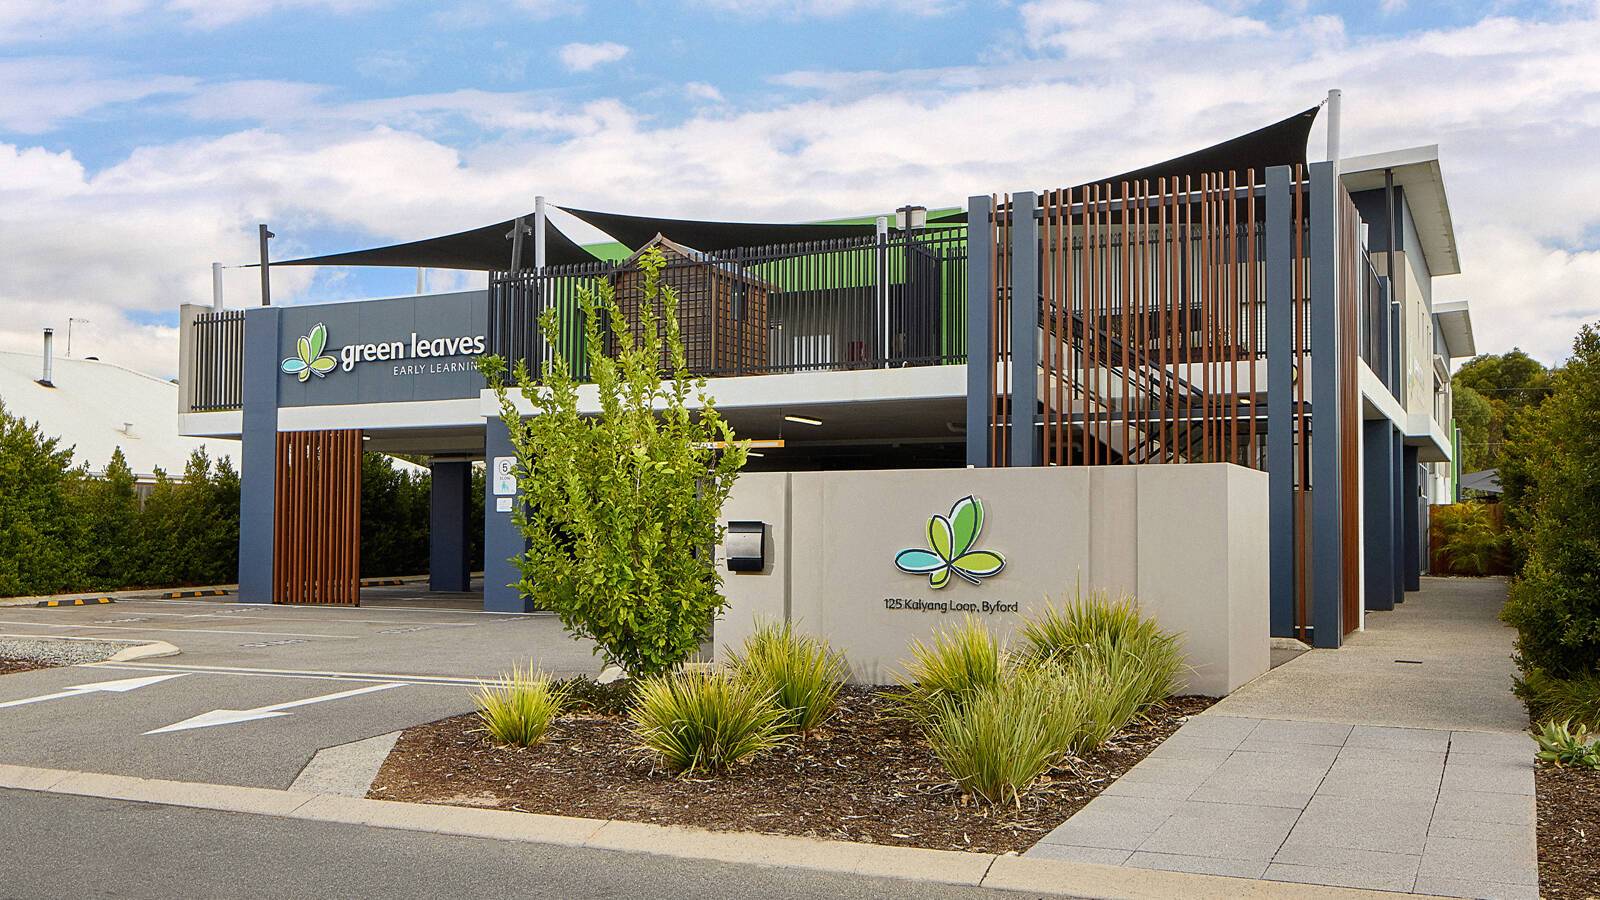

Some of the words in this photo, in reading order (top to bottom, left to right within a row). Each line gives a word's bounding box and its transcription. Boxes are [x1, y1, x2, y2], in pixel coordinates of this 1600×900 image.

[341, 341, 404, 372] green
[411, 333, 485, 358] leaves
[393, 364, 426, 376] EARLY
[430, 361, 478, 374] LEARNIN
[502, 463, 508, 472] 5
[884, 598, 902, 609] 125
[904, 598, 947, 613] Kalyang
[949, 600, 980, 613] Loop,
[982, 600, 1018, 614] Byford
